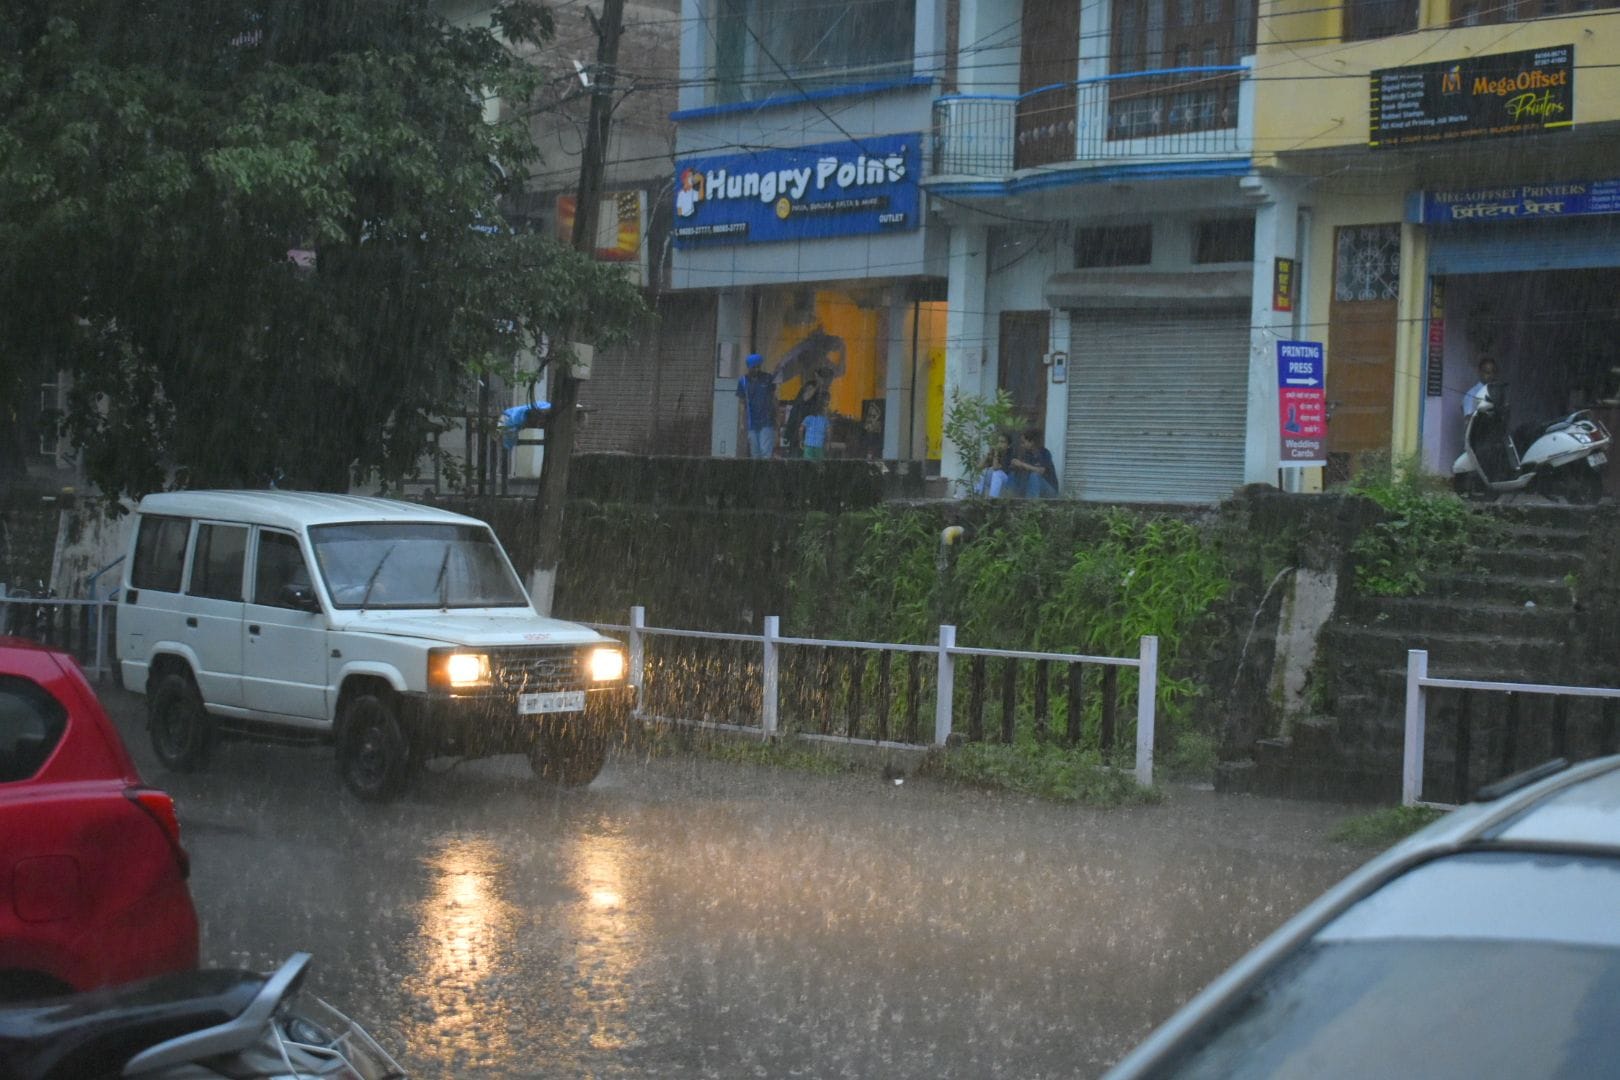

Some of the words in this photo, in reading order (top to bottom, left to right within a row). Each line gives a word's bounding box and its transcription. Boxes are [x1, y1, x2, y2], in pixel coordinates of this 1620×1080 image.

[1472, 69, 1567, 95] MegaOffset
[705, 166, 812, 203] Hungry
[816, 153, 906, 190] Point
[879, 213, 904, 223] OUTLET
[1281, 345, 1319, 358] PRINTING
[1289, 362, 1313, 374] PRESS
[1285, 439, 1320, 450] Wedding
[1291, 448, 1314, 458] Cards
